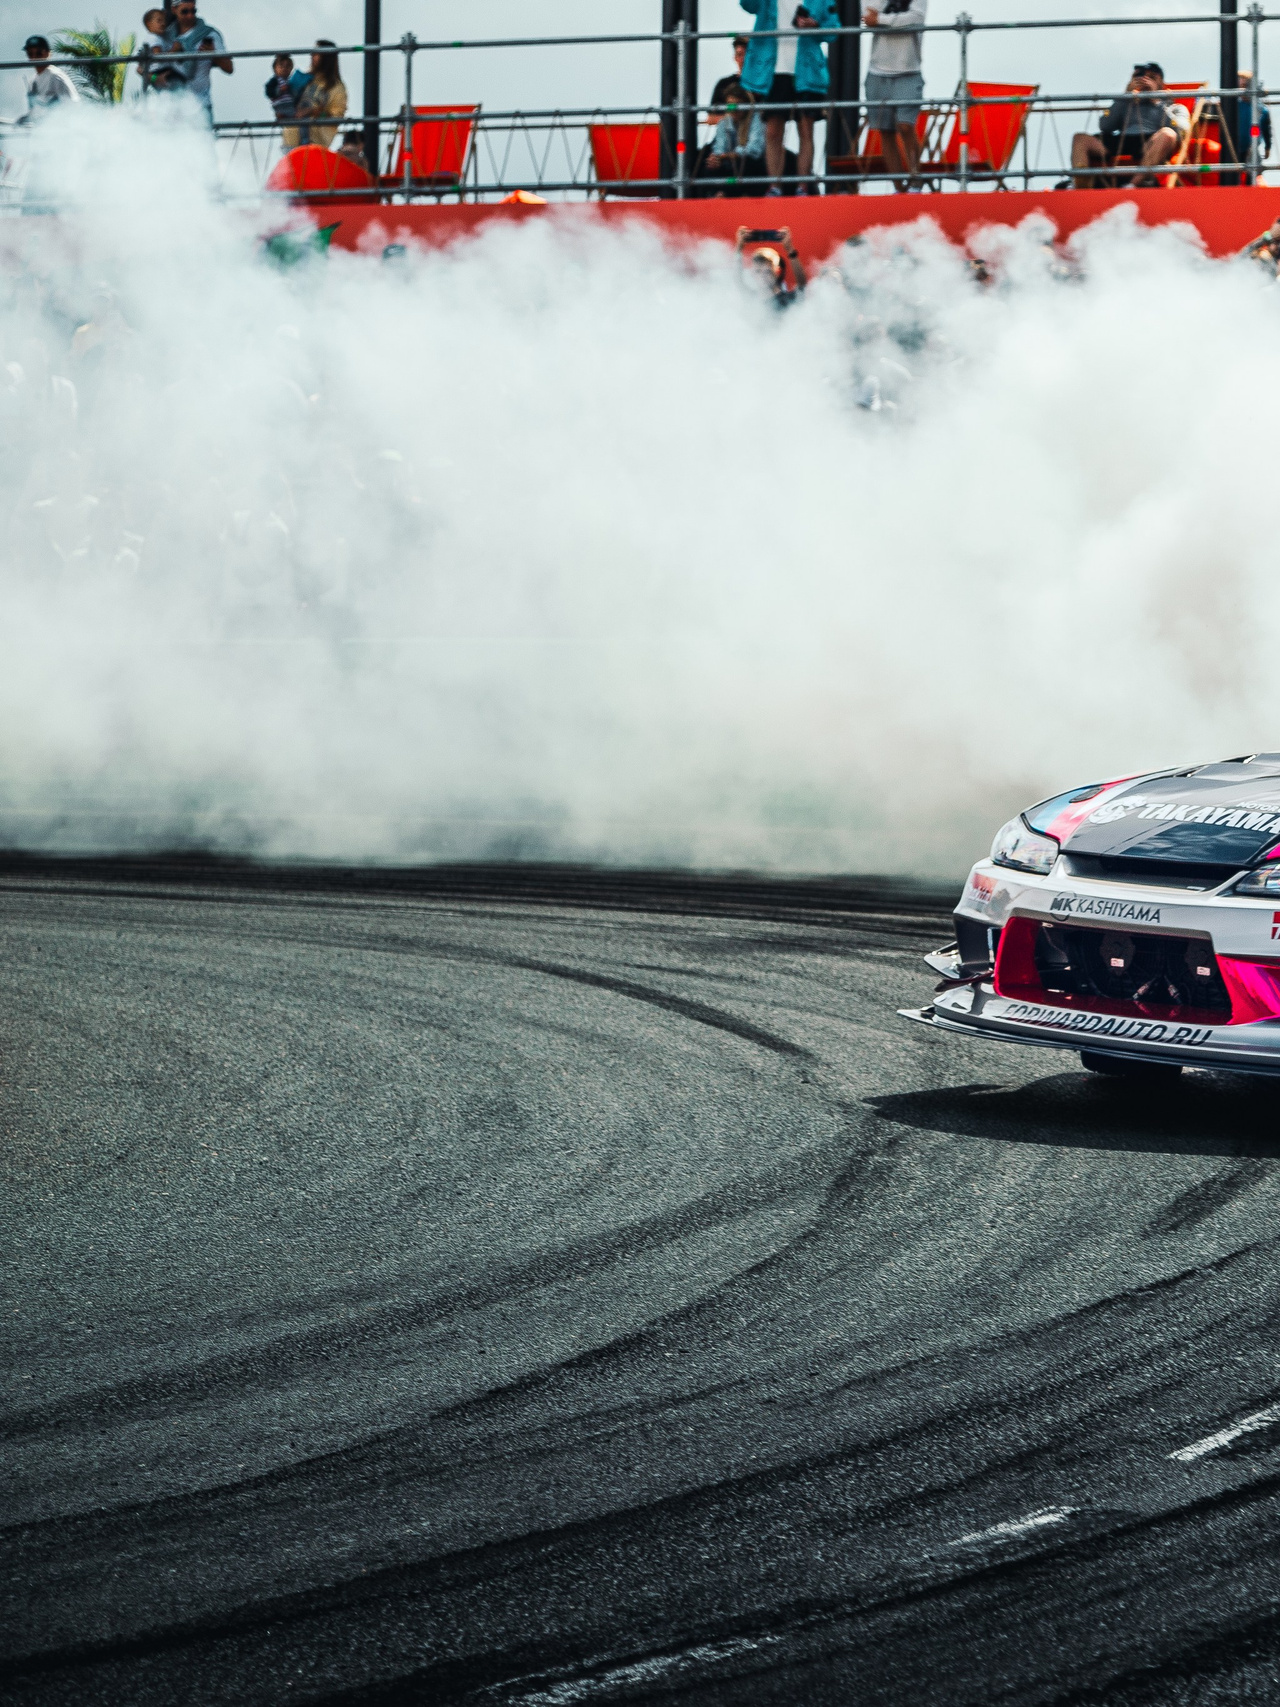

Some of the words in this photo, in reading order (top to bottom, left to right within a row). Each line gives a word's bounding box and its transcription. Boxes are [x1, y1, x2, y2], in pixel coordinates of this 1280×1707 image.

[1236, 802, 1278, 812] MOTOR
[1050, 896, 1074, 912] MK
[1075, 898, 1161, 924] KASHIYAMA
[1002, 1003, 1213, 1047] FORWARDAUTO.RU
